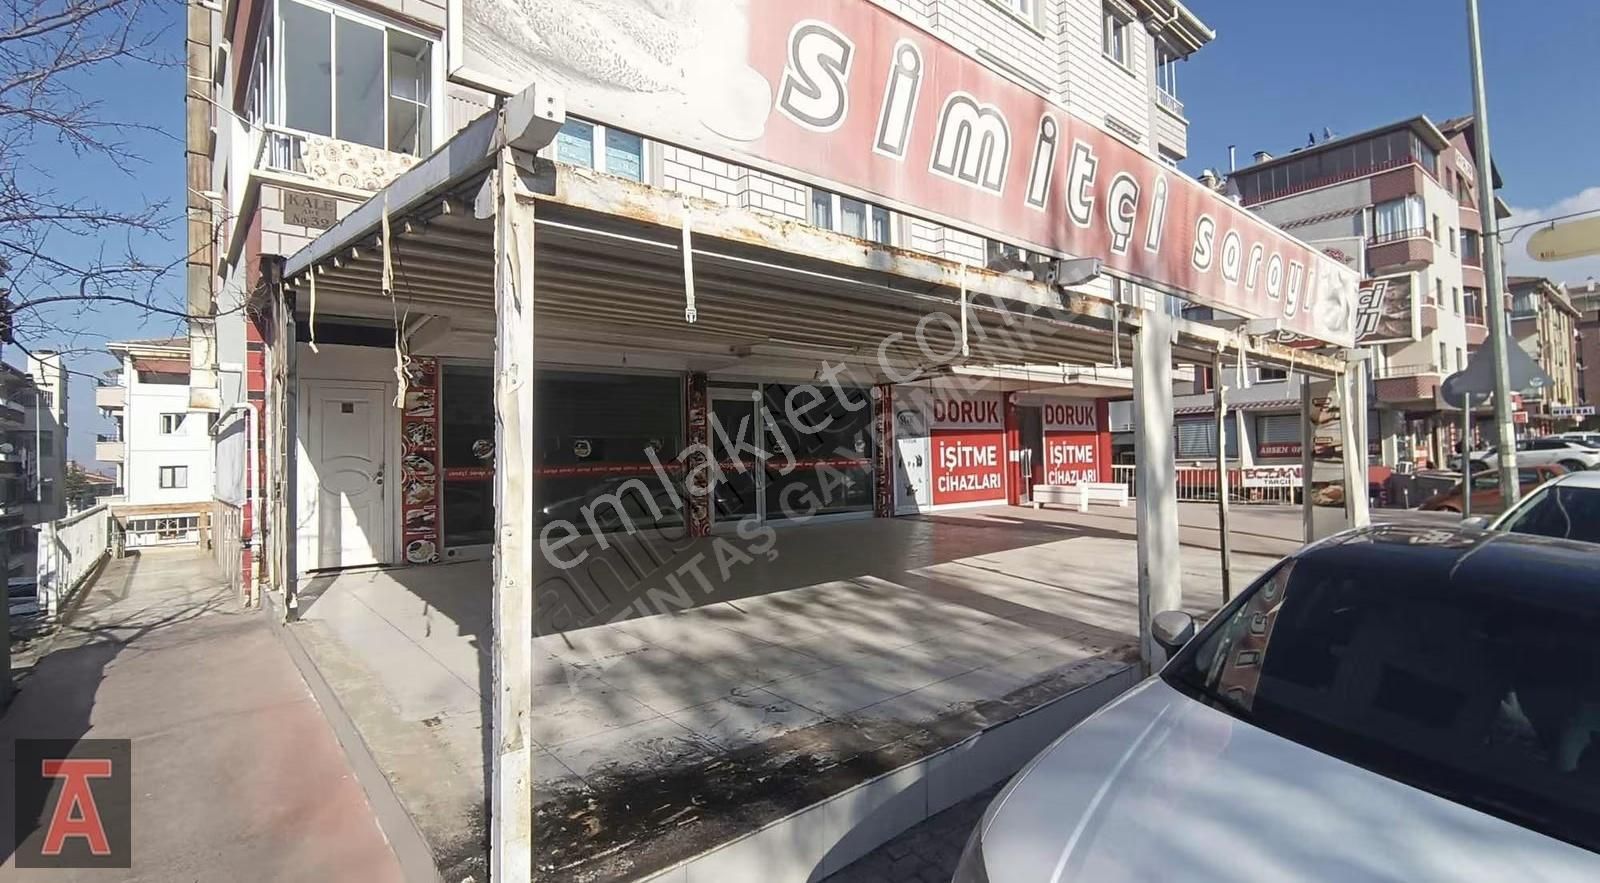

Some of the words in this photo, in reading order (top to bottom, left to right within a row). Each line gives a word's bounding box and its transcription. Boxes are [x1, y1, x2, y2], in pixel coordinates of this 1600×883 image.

[775, 18, 1168, 255] simitçi
[1191, 213, 1314, 319] sarayı
[289, 194, 333, 212] KALE
[932, 399, 1000, 423] DORUK
[1044, 403, 1095, 426] DORUK
[940, 439, 998, 472] İŞİTME
[1049, 440, 1094, 469] İŞİTME
[937, 469, 1001, 493] CİHAZLARI
[1048, 468, 1097, 485] CİHAZLARI
